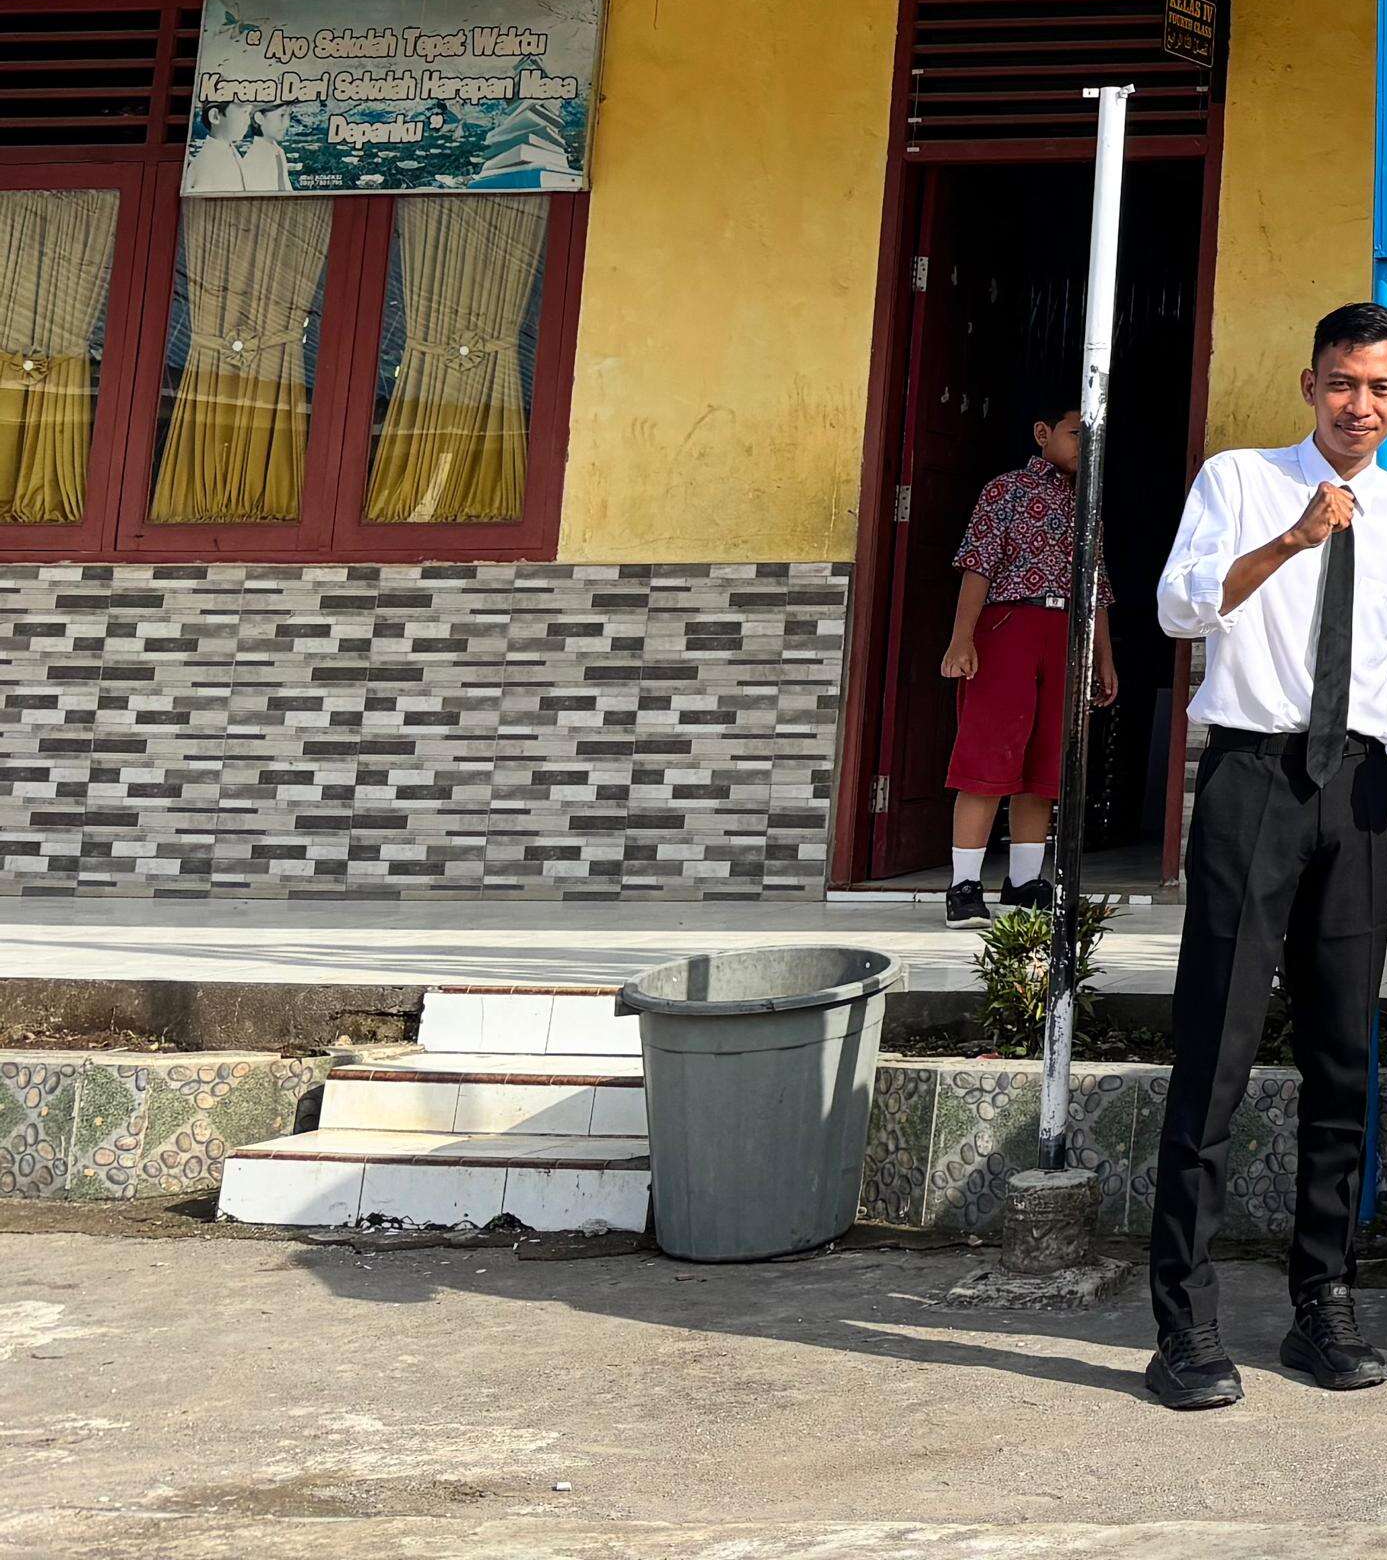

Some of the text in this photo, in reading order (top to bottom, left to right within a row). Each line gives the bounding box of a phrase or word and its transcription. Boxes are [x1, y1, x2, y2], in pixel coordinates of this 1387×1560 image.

[265, 29, 309, 64] Ayo
[314, 28, 398, 58] Sekolah
[402, 27, 467, 63] Tepat
[472, 26, 547, 57] Waktu
[198, 69, 578, 105] Karena Dari Sekolah Harapan Masa
[328, 113, 424, 150] Depanku
